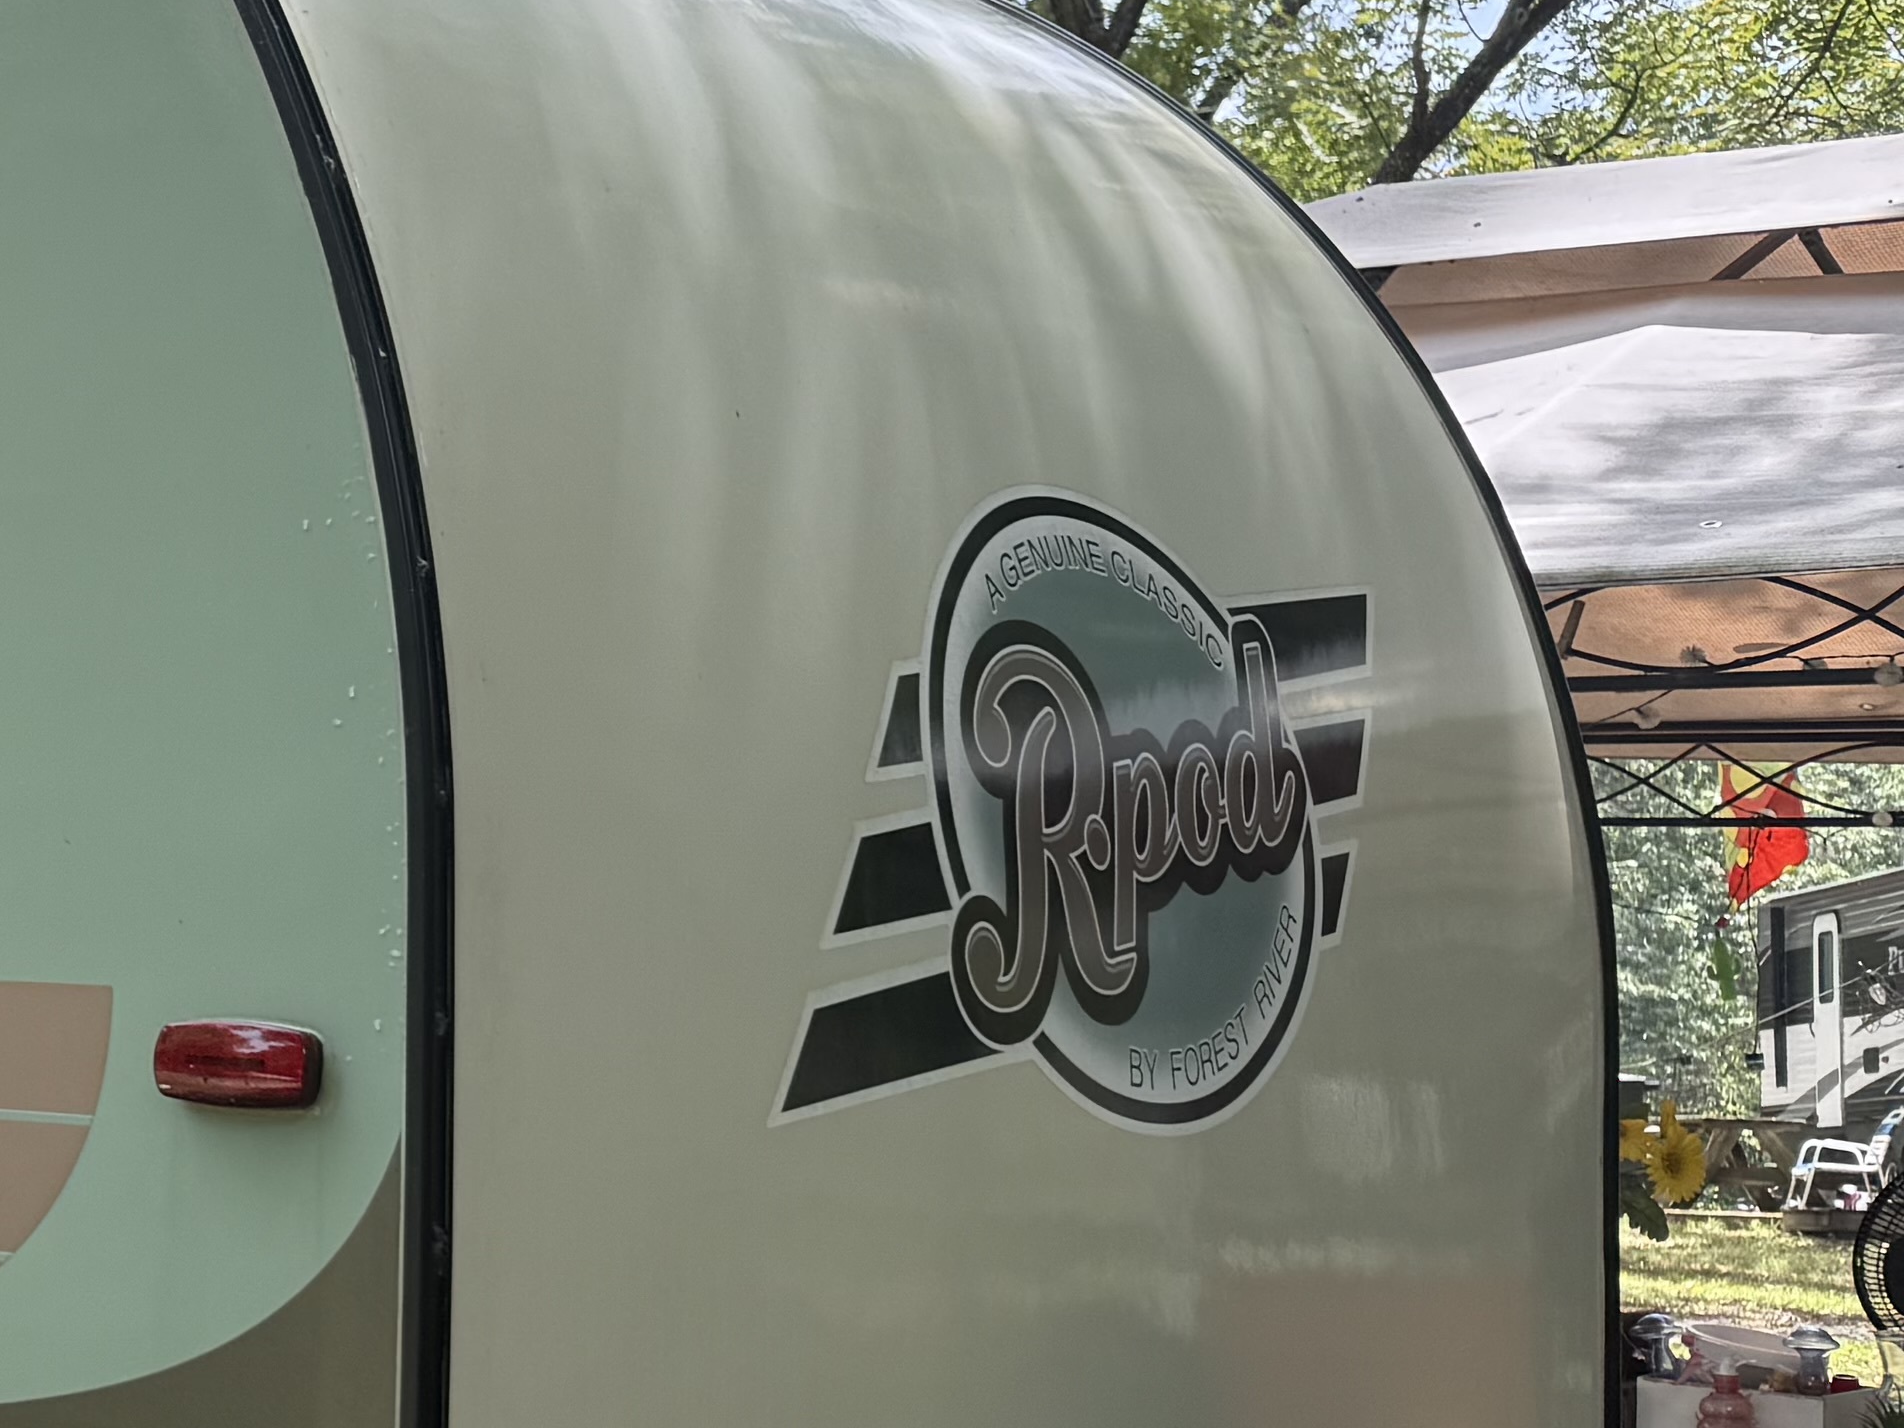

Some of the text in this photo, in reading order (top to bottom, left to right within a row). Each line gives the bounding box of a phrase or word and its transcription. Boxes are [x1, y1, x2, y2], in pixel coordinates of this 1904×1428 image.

[985, 535, 1224, 668] A GENUINE CLASSIC
[1129, 904, 1297, 1090] BY FOREST RIVER
